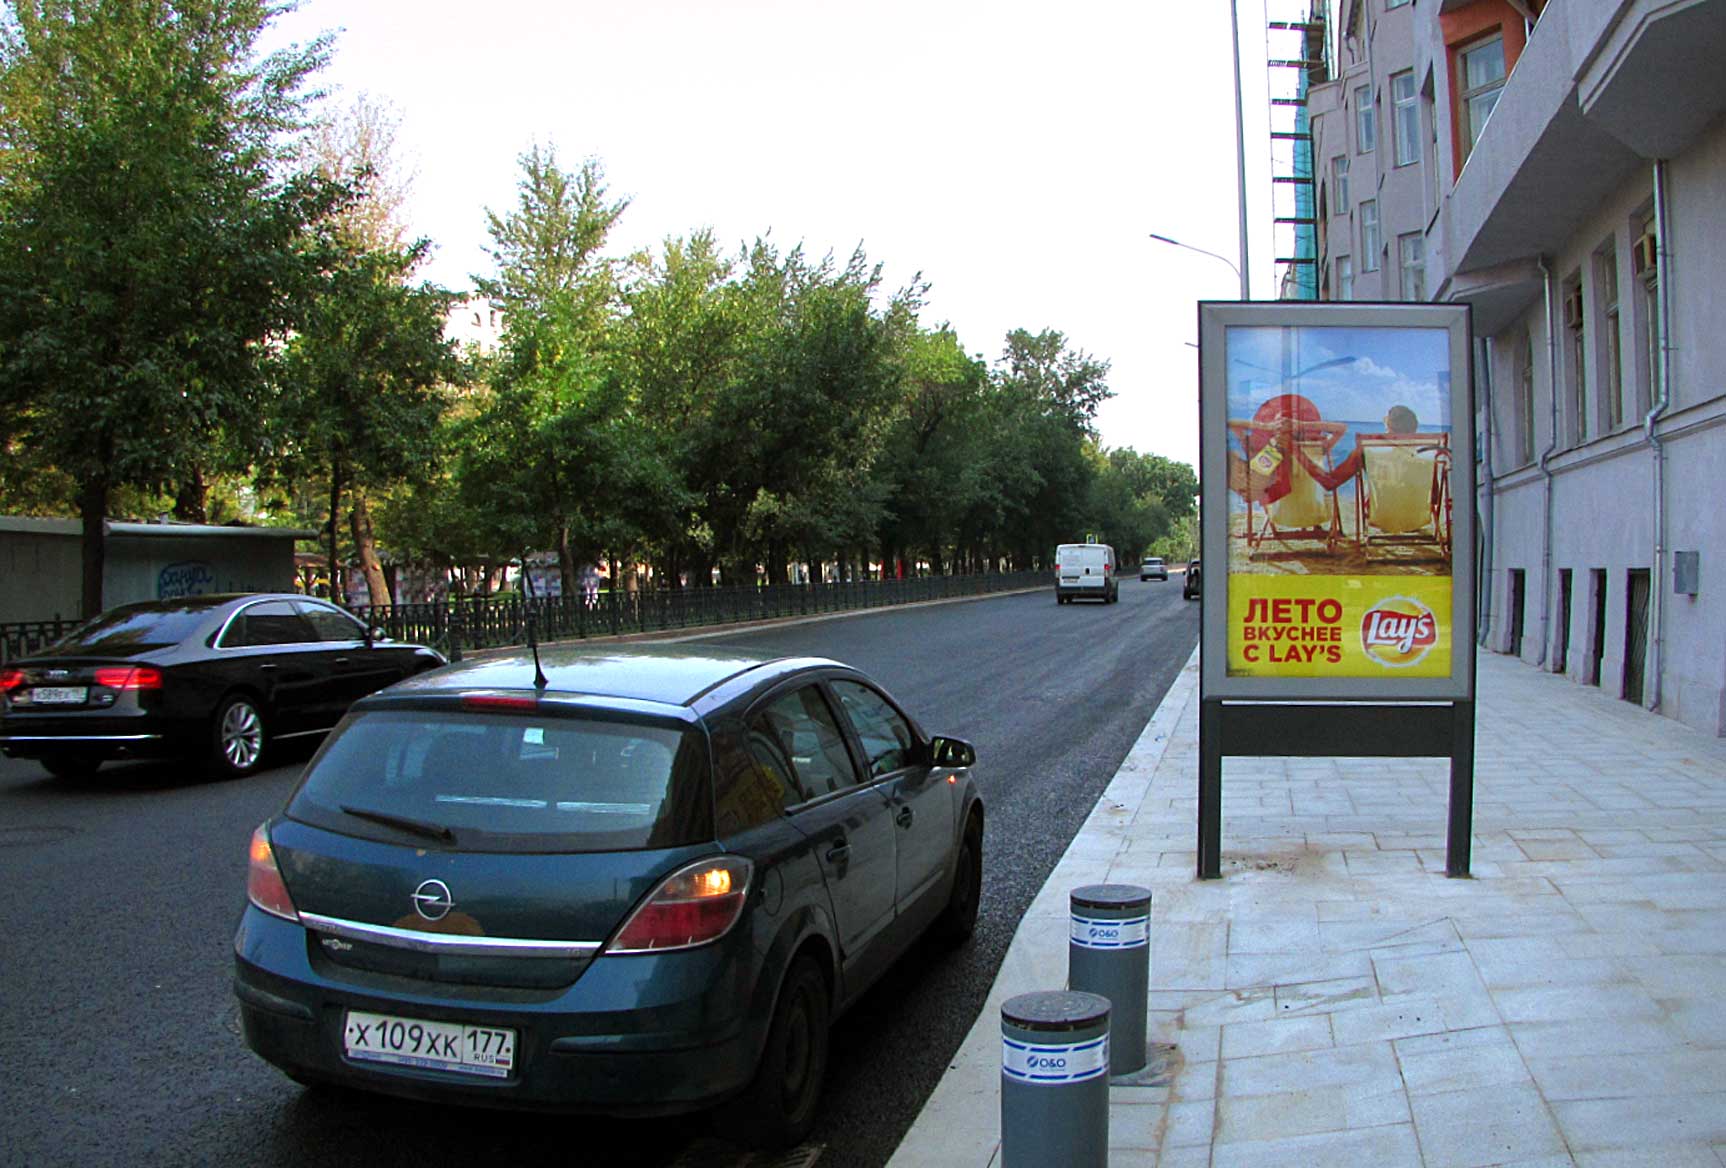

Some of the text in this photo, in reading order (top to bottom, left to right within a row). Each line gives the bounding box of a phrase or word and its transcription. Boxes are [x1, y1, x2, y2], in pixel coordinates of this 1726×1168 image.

[1243, 598, 1343, 624] ЛЕТО
[1243, 626, 1342, 642] ВКУСНЕЕ
[1368, 612, 1432, 654] Lay's
[467, 1029, 507, 1056] 177
[474, 1053, 495, 1063] RUS
